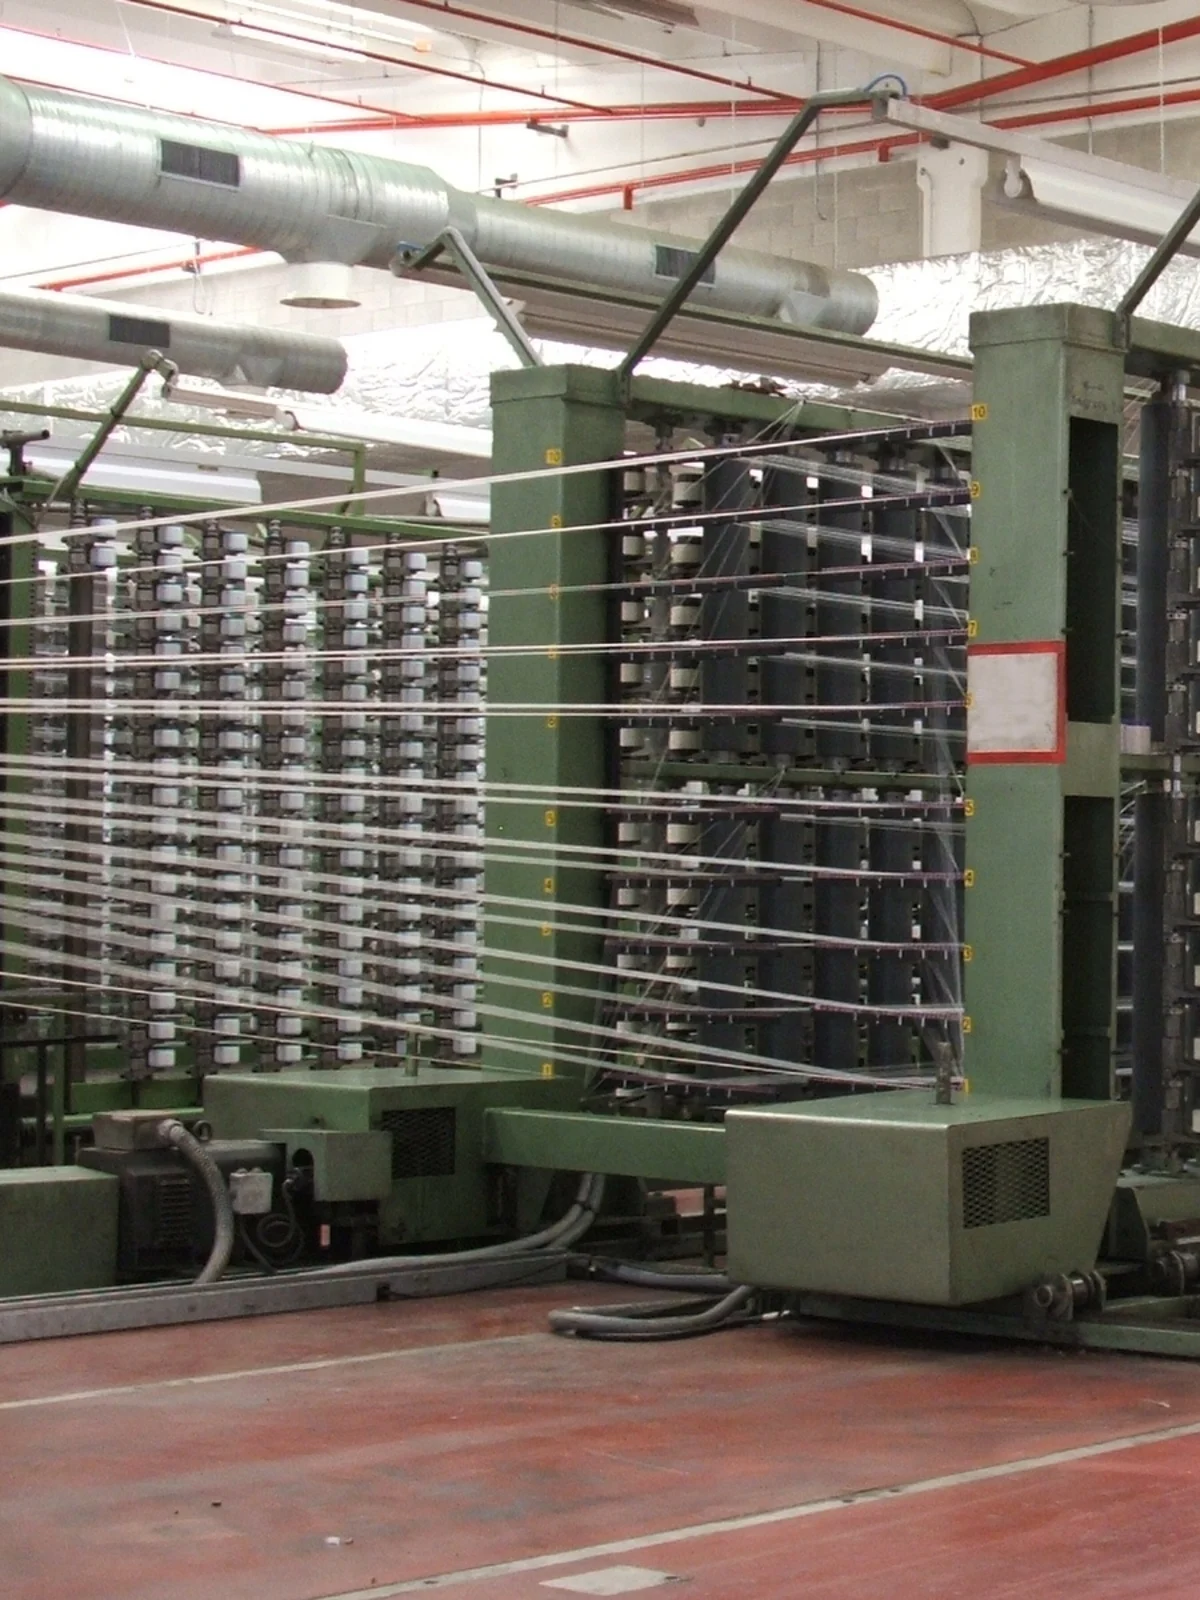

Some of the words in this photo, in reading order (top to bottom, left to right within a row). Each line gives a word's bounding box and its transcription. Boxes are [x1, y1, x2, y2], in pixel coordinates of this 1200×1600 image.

[973, 405, 986, 419] 10
[971, 482, 979, 496] 9
[969, 621, 976, 635] 7
[965, 801, 973, 814] 5
[962, 1018, 970, 1031] 2
